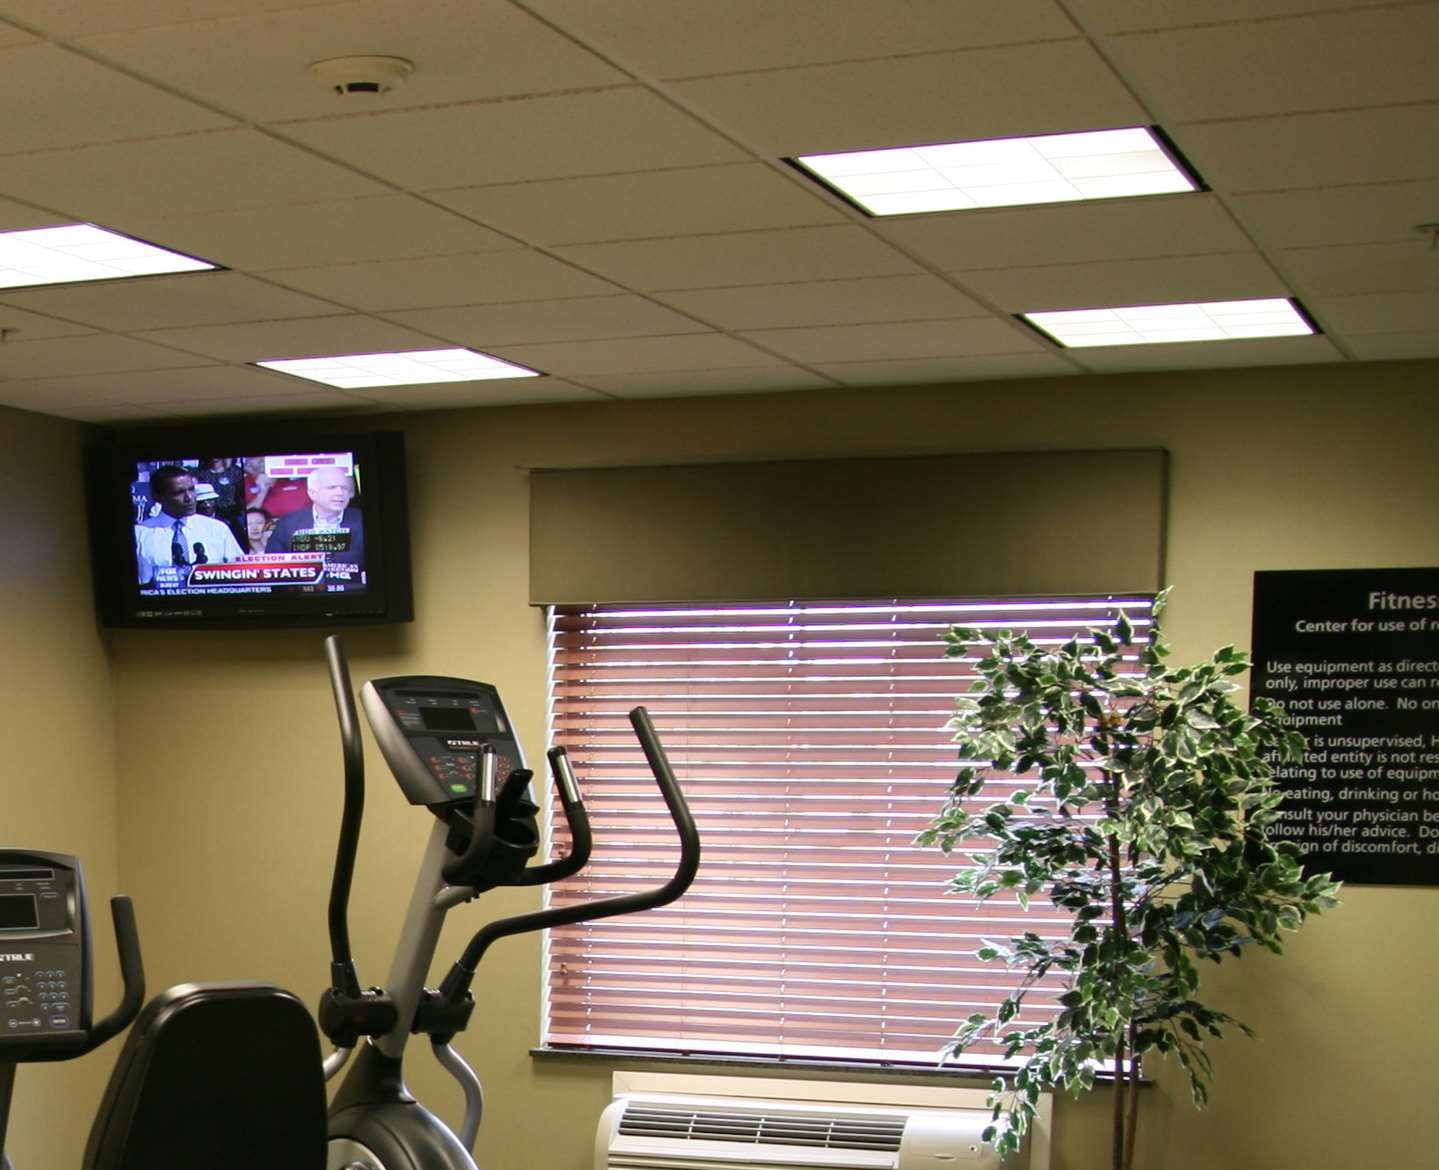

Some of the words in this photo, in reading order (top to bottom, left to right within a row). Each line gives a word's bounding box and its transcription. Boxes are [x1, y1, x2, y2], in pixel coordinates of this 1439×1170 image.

[235, 554, 285, 562] ELECTION
[194, 569, 260, 581] SWINGIN'
[263, 567, 317, 579] STATES
[207, 586, 272, 594] HEADQUARTERS
[1368, 591, 1439, 610] Fitnes
[1295, 619, 1347, 633] Center
[1351, 618, 1375, 632] for
[1378, 620, 1405, 632] use
[1409, 617, 1427, 631] of
[1266, 660, 1291, 673] Use
[1295, 659, 1374, 675] equipment
[1377, 662, 1393, 672] as
[1265, 676, 1299, 691] only,
[1303, 676, 1369, 691] improper
[1373, 678, 1398, 688] use
[1401, 678, 1426, 688] can
[1289, 699, 1313, 710] not
[1318, 700, 1342, 710] use
[1344, 698, 1389, 710] alone.
[1396, 697, 1417, 710] No
[1314, 733, 1325, 747] is
[1328, 733, 1427, 749] unsupervised,
[1331, 751, 1373, 765] entity
[1377, 751, 1387, 763] is
[1391, 753, 1415, 763] not
[1419, 753, 1439, 763] res
[1268, 767, 1317, 781] elating
[1321, 768, 1336, 779] to
[1340, 769, 1363, 779] use
[1367, 767, 1382, 779] of
[1386, 767, 1439, 781] equipm
[1285, 787, 1334, 803] eating,
[1338, 786, 1399, 804] drinking
[1403, 790, 1419, 800] or
[1317, 810, 1348, 823] your
[1353, 808, 1419, 824] physician
[1309, 824, 1357, 836] his/her
[1361, 825, 1411, 837] advice.
[1419, 825, 1439, 838] Do
[1322, 840, 1338, 852] of
[1341, 841, 1422, 855] discomfort,
